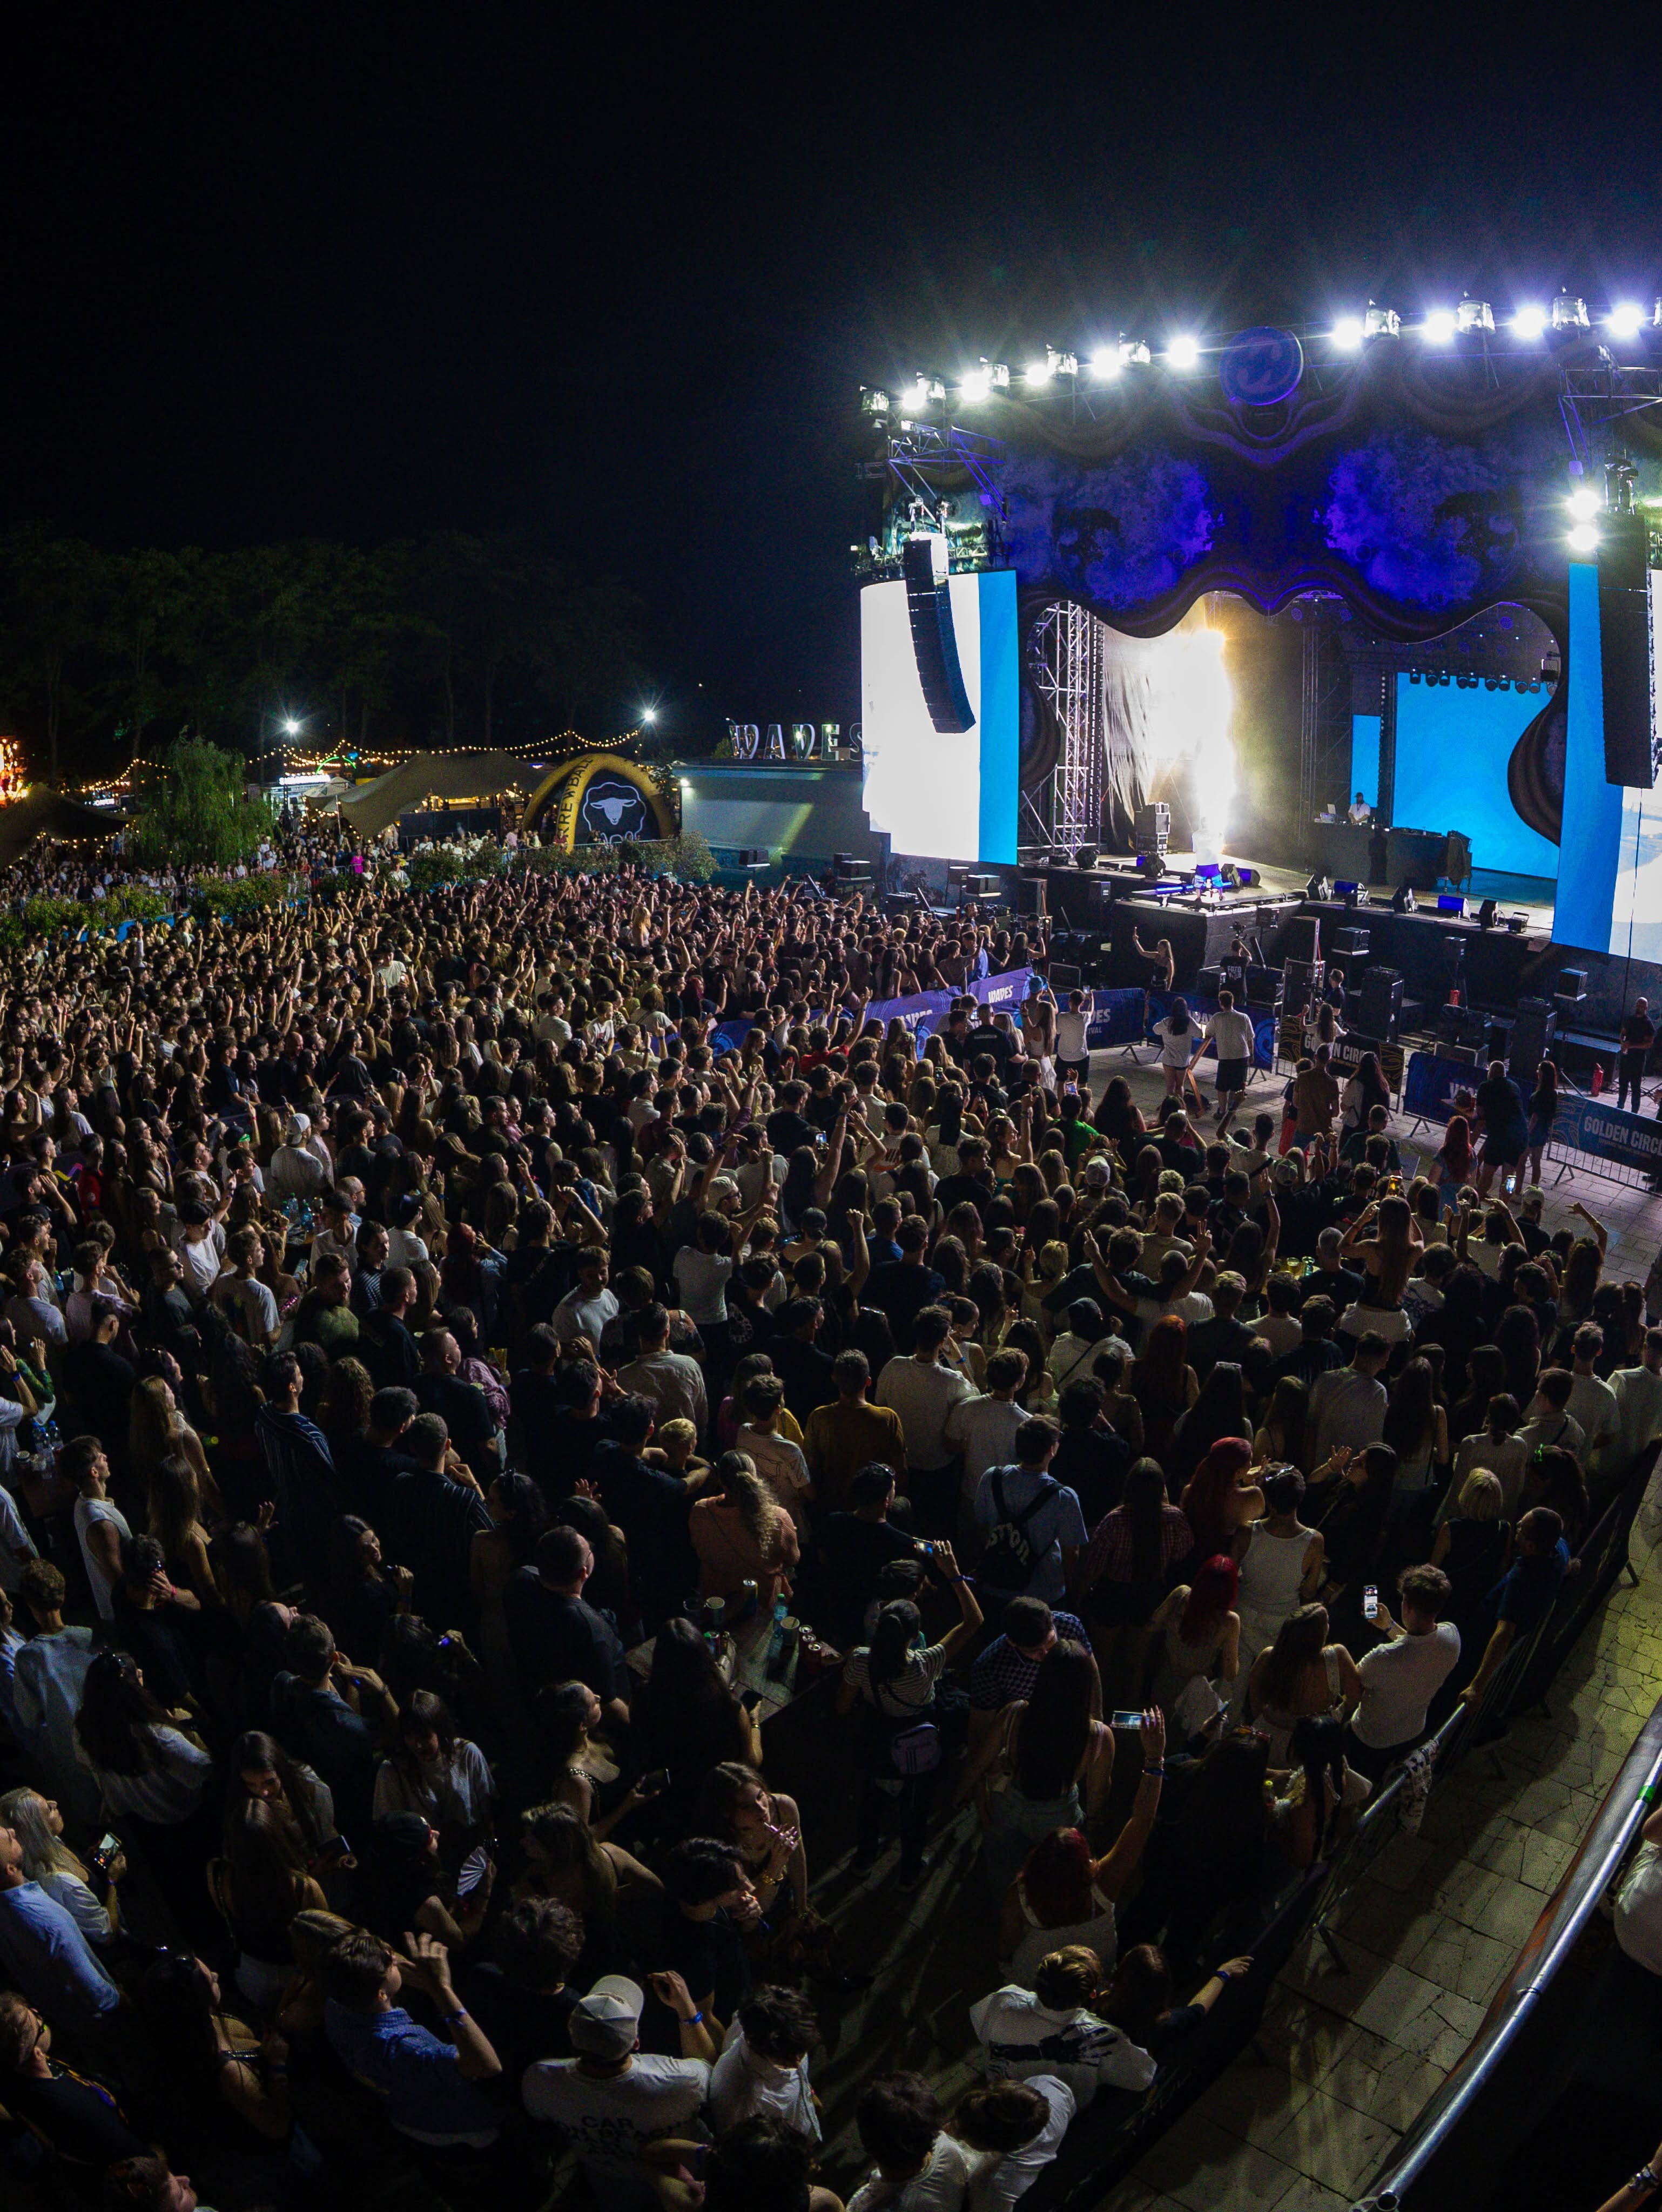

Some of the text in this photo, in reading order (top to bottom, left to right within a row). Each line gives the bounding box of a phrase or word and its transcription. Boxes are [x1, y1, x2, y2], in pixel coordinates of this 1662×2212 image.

[988, 985, 1013, 1003] WAVES
[1584, 1115, 1630, 1144] GOLDEN
[1630, 1130, 1662, 1157] CIRCL
